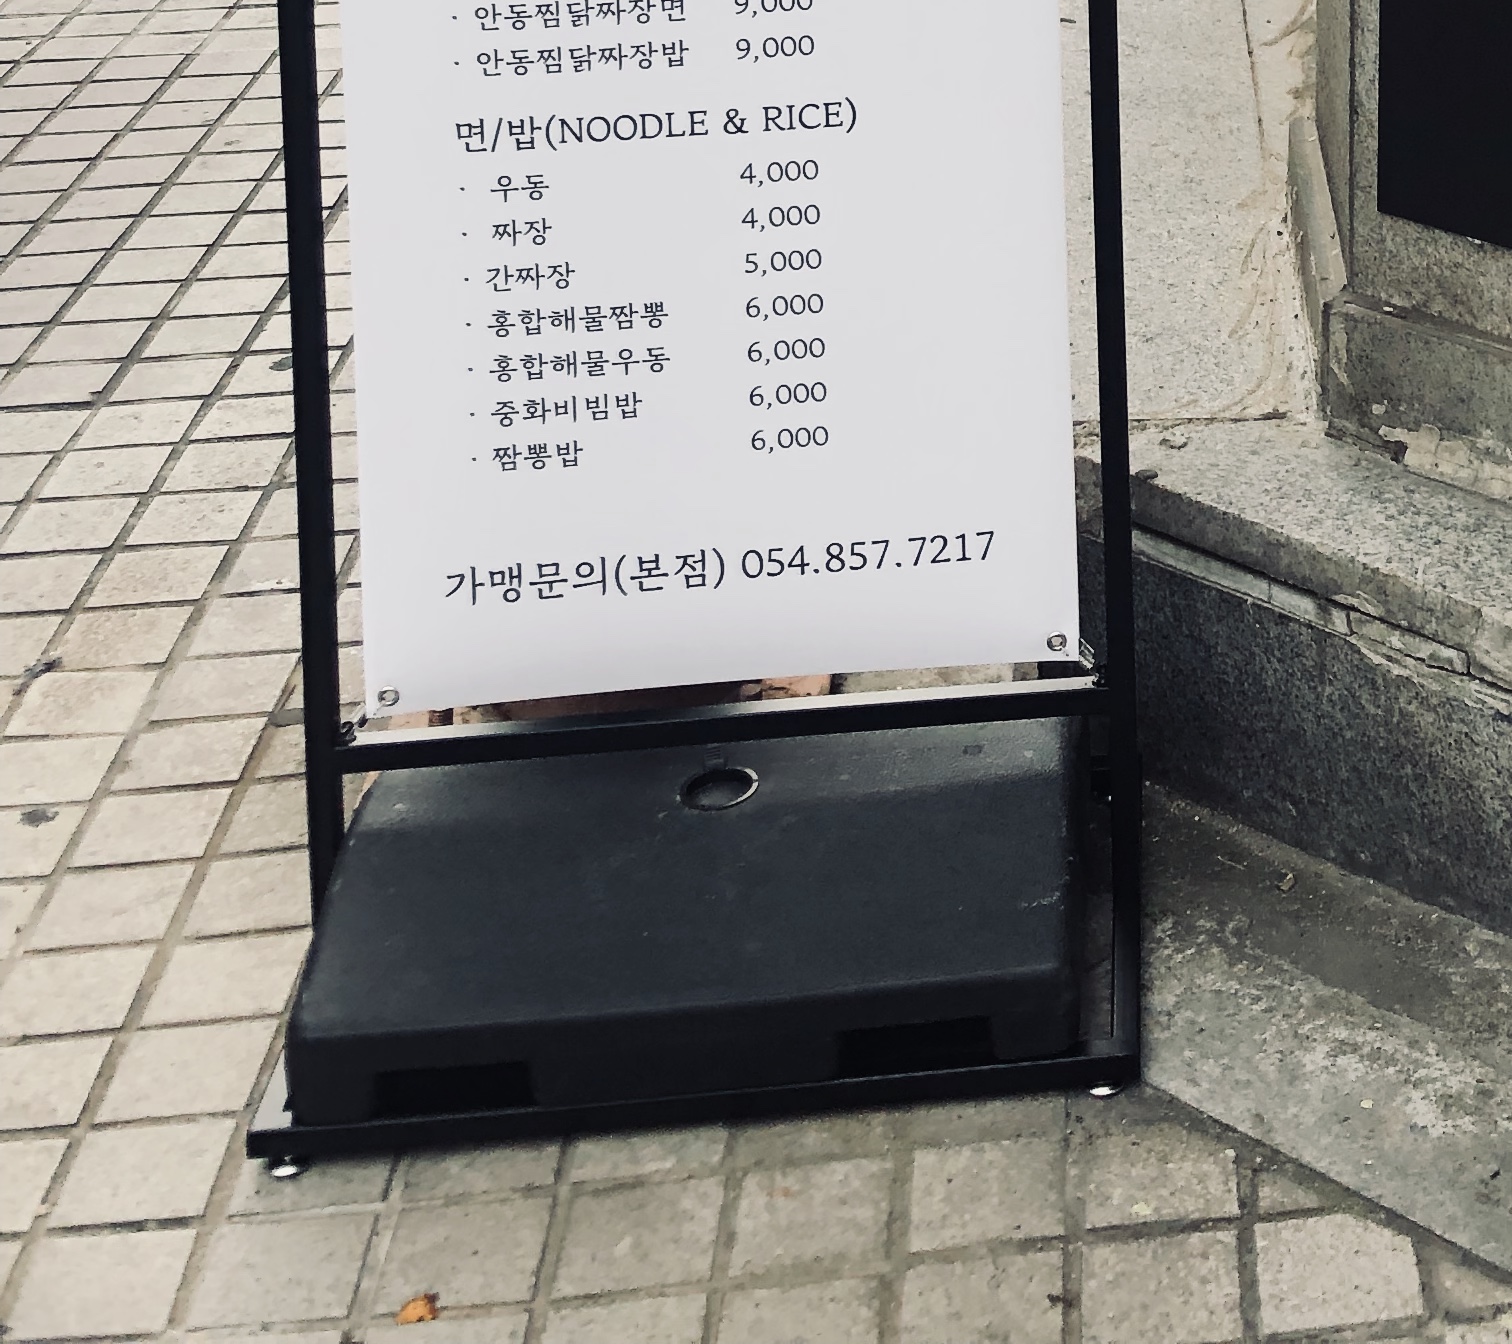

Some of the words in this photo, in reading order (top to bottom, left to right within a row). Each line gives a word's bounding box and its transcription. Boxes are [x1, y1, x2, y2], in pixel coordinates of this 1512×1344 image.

[477, 40, 689, 76] 안동찜닭짜장밥
[736, 35, 814, 63] 9,000
[456, 110, 708, 152] 면/밥(NOODLE
[723, 109, 749, 134] &
[762, 97, 856, 133] RICE)
[490, 175, 549, 202] 우동
[740, 160, 818, 187] 4,000
[492, 218, 552, 246] 짜장
[742, 205, 820, 232] 4,000
[486, 262, 575, 292] 간짜장
[745, 249, 822, 277] 5,000
[487, 301, 668, 337] 홍합해물짬뽕
[746, 294, 823, 321] 6,000
[489, 347, 670, 382] 홍합해물우동
[748, 338, 825, 365] 6,000
[491, 392, 642, 427] 중화비빔밥
[750, 382, 827, 410] 6,000
[493, 440, 583, 471] 짬뽕밥
[751, 426, 828, 454] 6,000
[445, 548, 724, 605] 가맹문의(본점)
[742, 531, 994, 578] 054.857.7217
